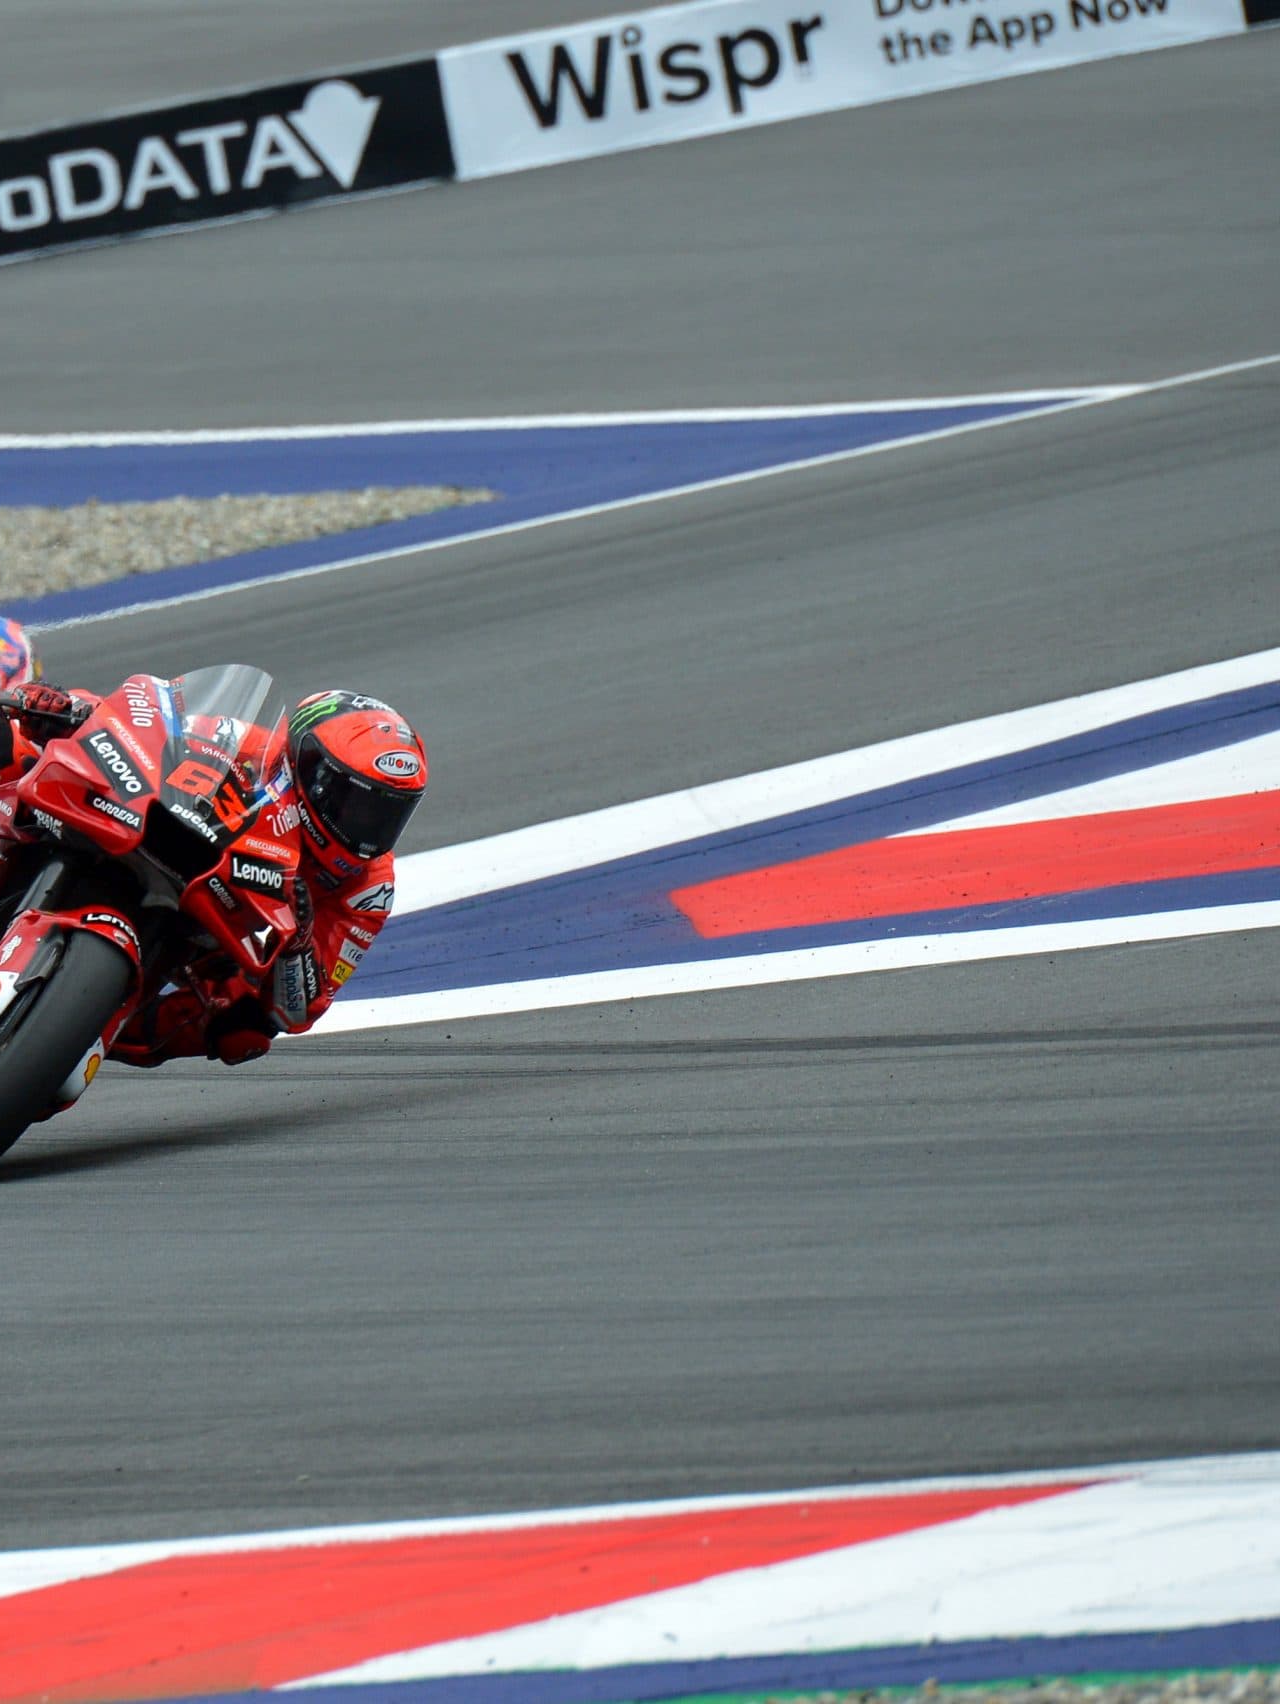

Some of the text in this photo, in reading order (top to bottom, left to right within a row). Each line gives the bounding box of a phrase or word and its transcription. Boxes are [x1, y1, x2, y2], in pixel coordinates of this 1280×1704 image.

[880, 28, 952, 65] the
[967, 11, 1056, 50] App
[506, 15, 824, 130] Wispr
[89, 732, 142, 793] Lenovo
[93, 797, 140, 828] CARRERA
[170, 803, 218, 843] DUCATI
[298, 801, 324, 845] Lenovo
[232, 857, 283, 889] Lenovo
